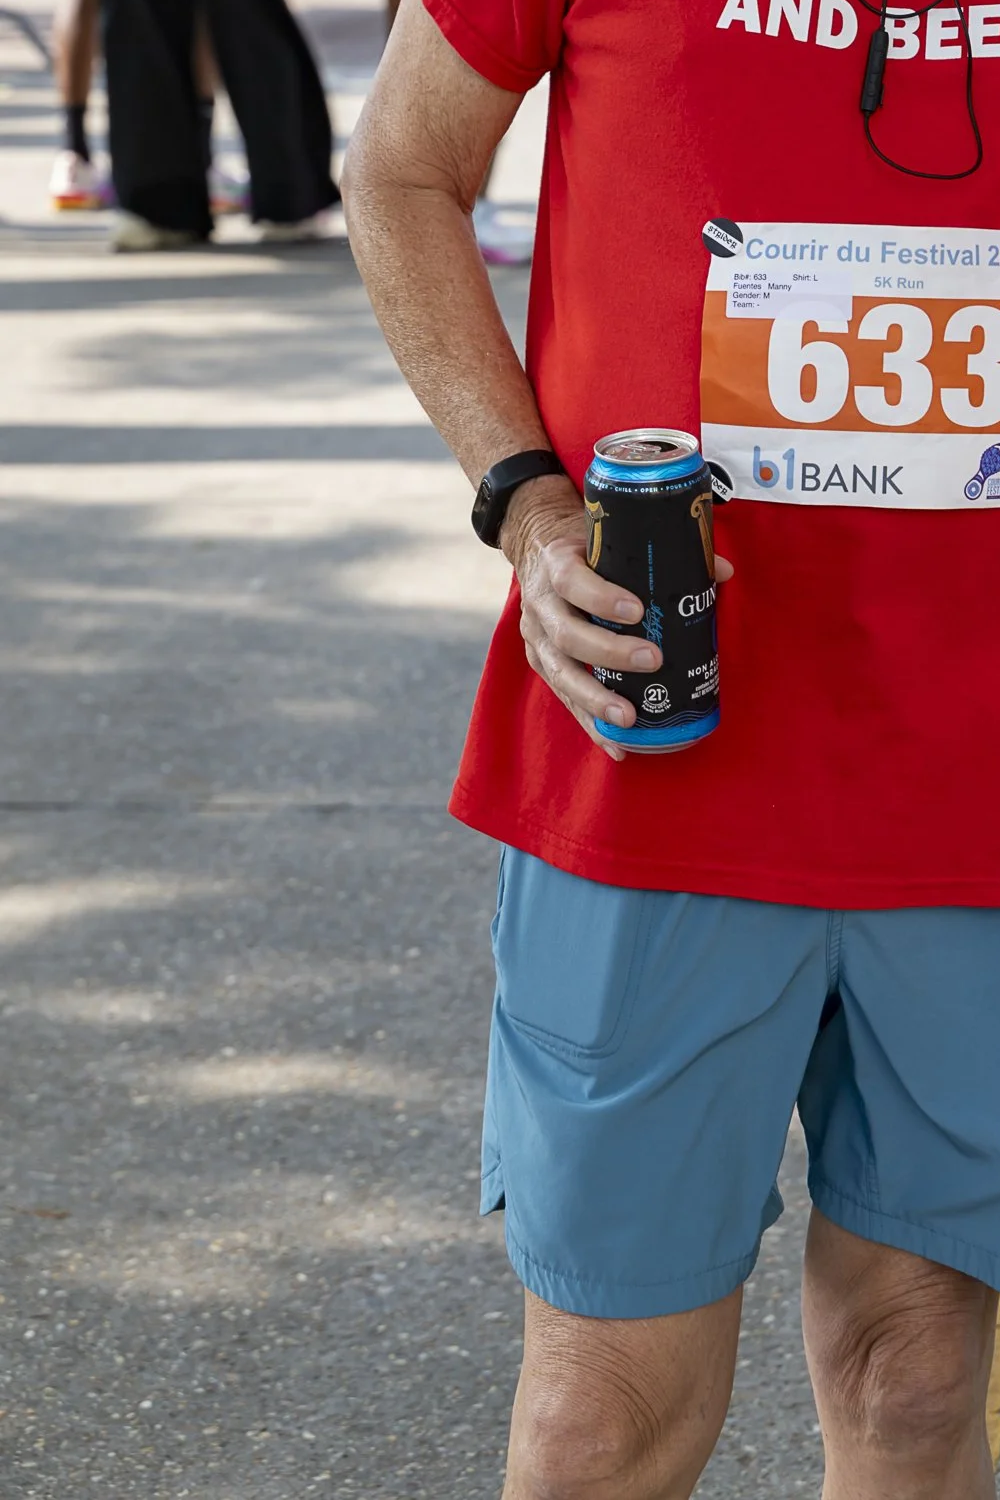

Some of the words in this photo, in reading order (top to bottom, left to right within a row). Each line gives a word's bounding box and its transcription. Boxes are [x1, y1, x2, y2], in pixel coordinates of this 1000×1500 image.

[746, 238, 829, 261] Courir
[837, 240, 870, 263] du
[881, 241, 980, 266] Festival
[733, 273, 751, 281] Bib#:
[753, 273, 767, 281] 633
[792, 273, 812, 282] Shirt:
[813, 274, 819, 282] L
[874, 276, 893, 288] 5K
[897, 277, 925, 289] Run
[768, 283, 792, 292] Manny
[688, 663, 707, 678] NON
